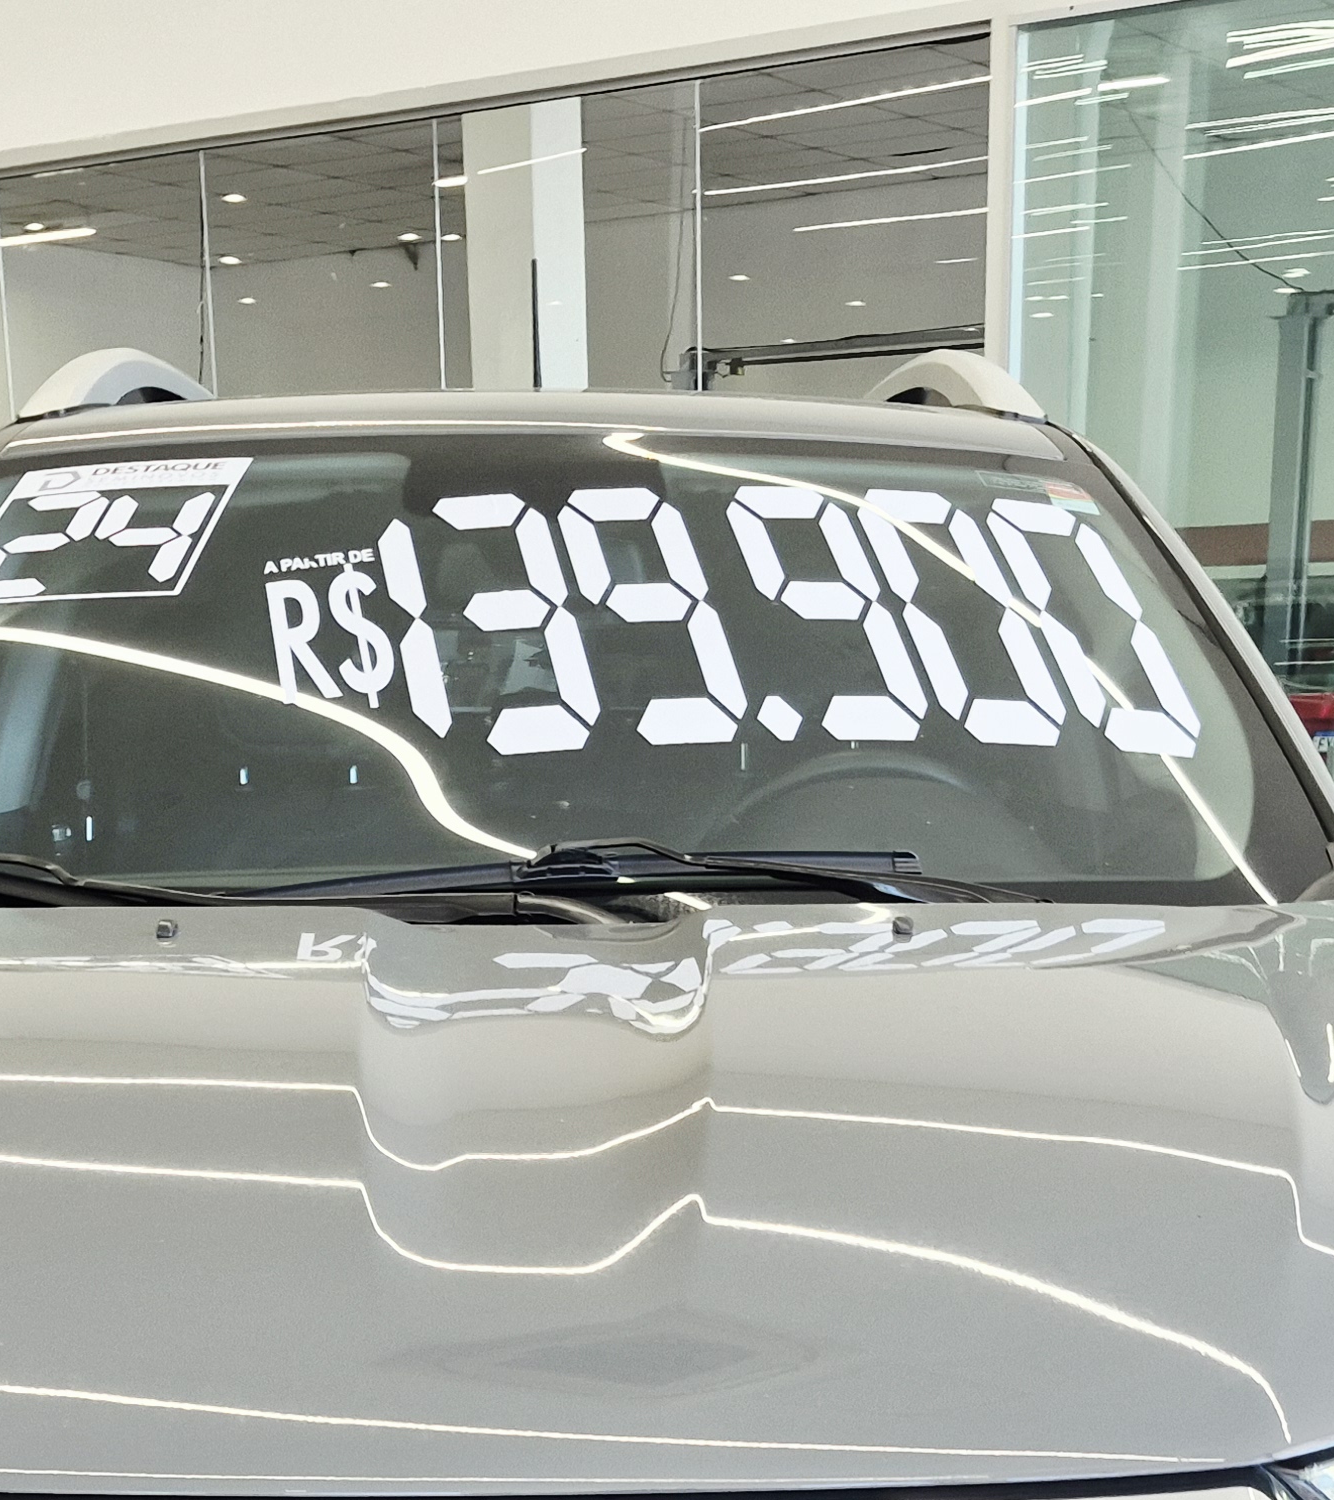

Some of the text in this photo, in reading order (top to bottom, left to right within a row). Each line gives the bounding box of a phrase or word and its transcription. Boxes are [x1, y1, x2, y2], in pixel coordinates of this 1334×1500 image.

[92, 461, 227, 476] DESTAQUE
[264, 548, 375, 574] A PARTIR DE
